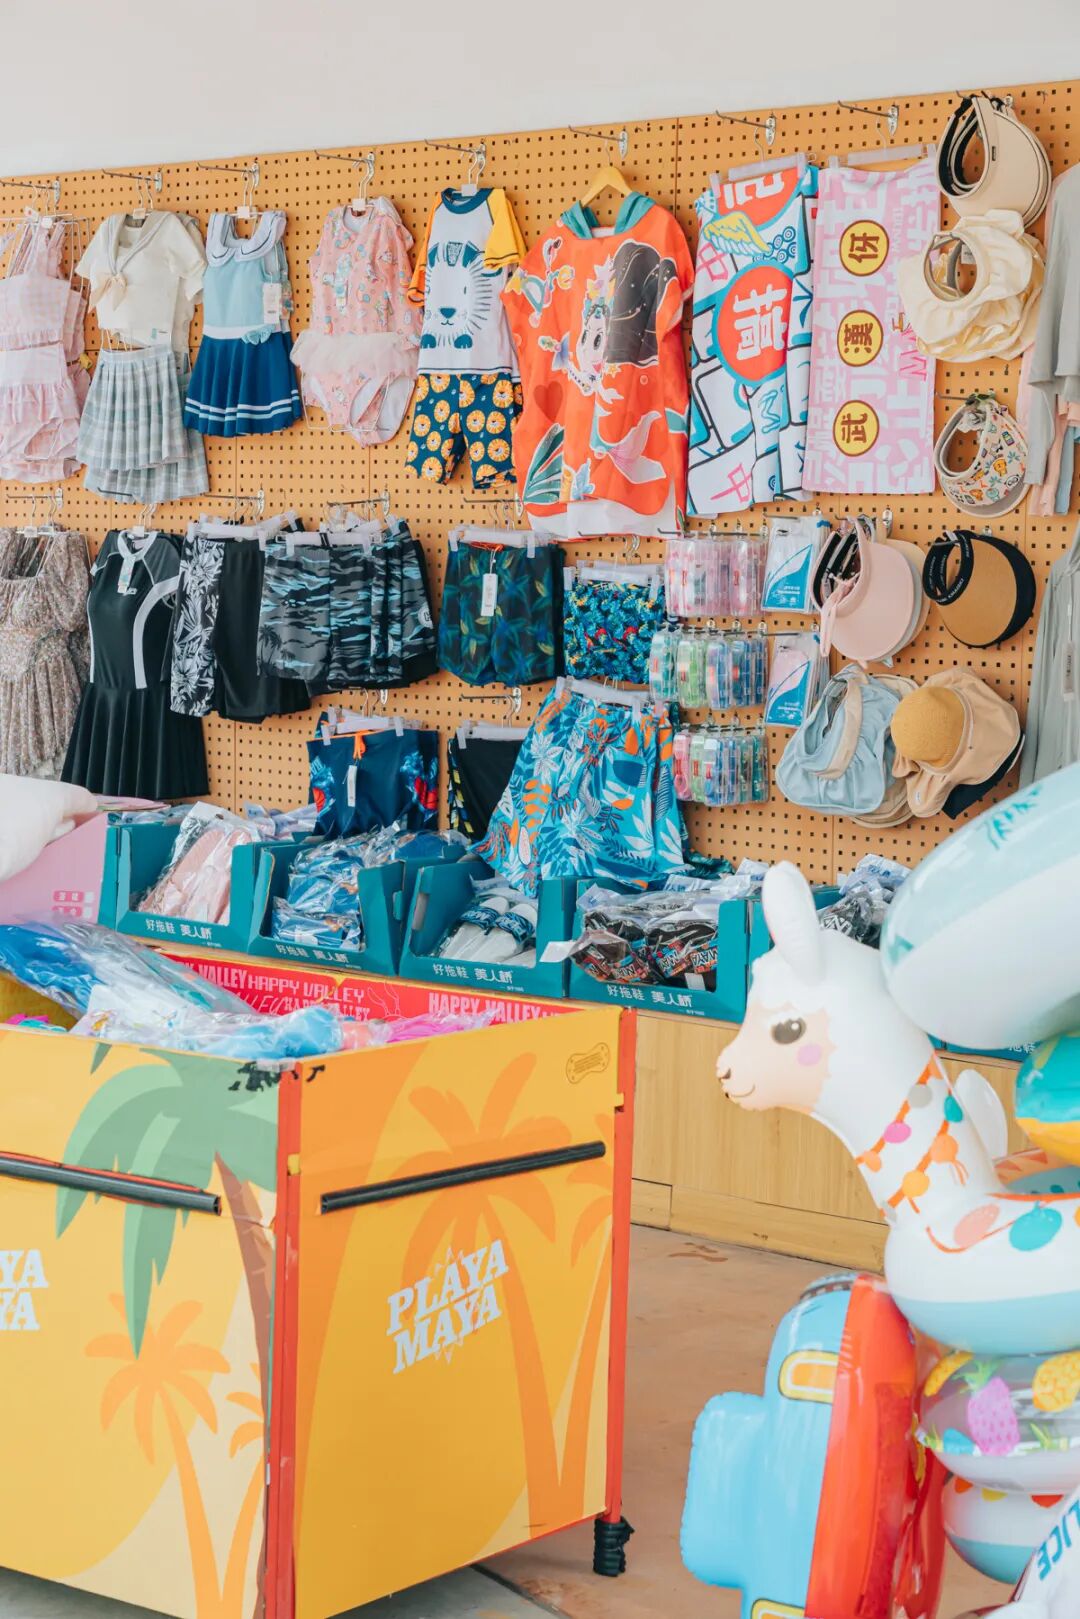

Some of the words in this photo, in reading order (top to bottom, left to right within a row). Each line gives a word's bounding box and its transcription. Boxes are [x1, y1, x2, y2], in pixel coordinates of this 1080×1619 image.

[732, 284, 788, 360] 搞
[247, 974, 300, 995] HAPPY
[303, 982, 365, 1003] VALLEY
[386, 1240, 509, 1336] PLAYA
[393, 1284, 502, 1374] MAYA
